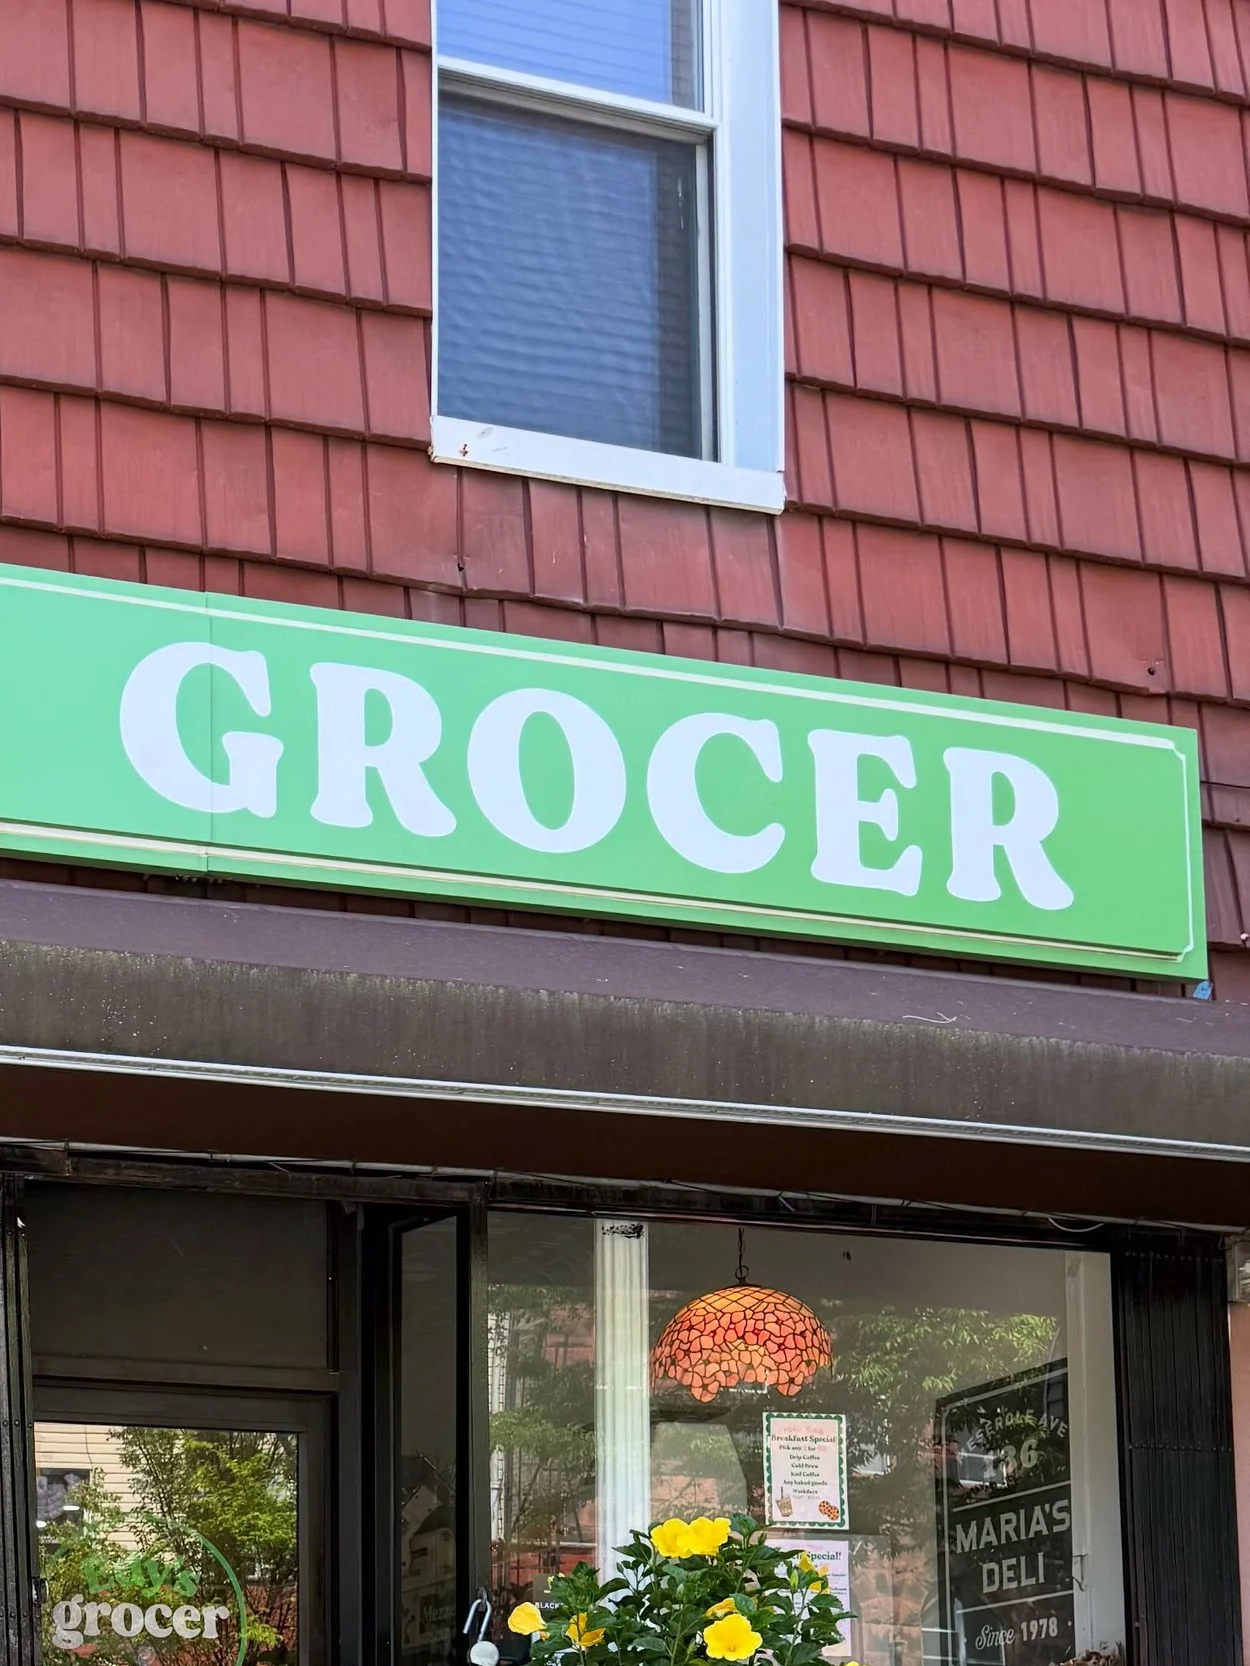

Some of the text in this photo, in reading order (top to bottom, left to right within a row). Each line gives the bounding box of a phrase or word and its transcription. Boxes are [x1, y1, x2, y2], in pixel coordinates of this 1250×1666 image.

[119, 639, 1077, 913] GROCER
[771, 1434, 808, 1442] Breakfast
[1038, 1412, 1068, 1438] AVE
[956, 1499, 1071, 1553] MARIA'S
[981, 1551, 1045, 1594] DELI
[52, 1593, 230, 1650] grocer
[975, 1617, 1058, 1650] Since 1978
